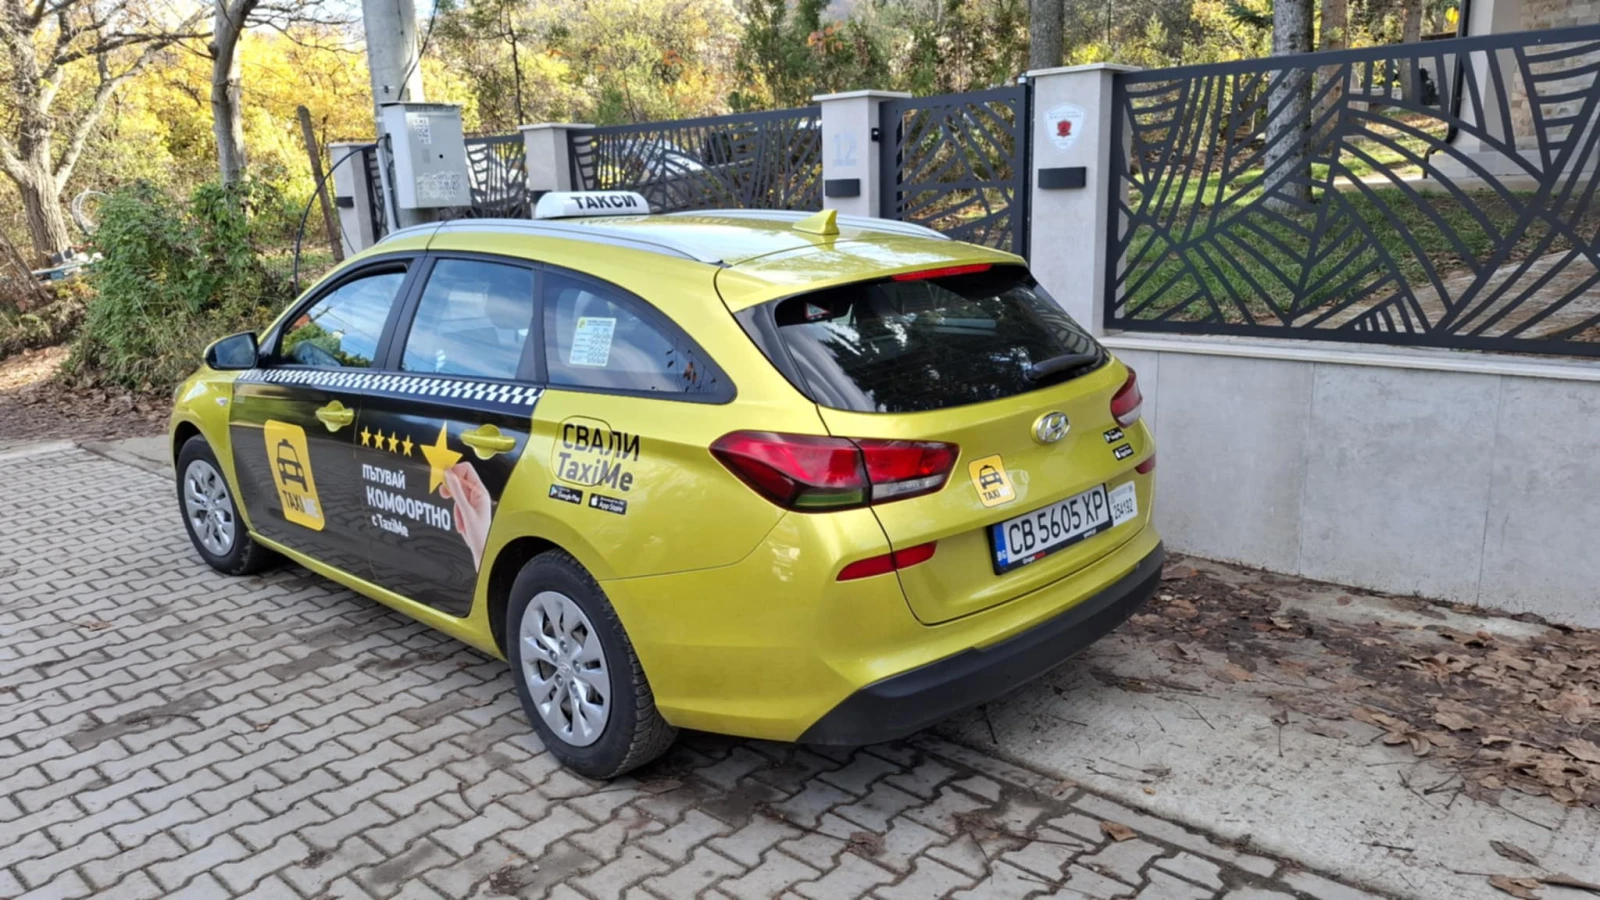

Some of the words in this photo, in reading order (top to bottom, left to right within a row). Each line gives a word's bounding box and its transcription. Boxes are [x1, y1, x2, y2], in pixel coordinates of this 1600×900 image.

[570, 194, 638, 210] ТАКСИ
[562, 422, 640, 462] СВАЛИ
[362, 463, 406, 490] ПЪТУВАЙ
[557, 451, 634, 492] TaxiMe
[366, 485, 451, 531] КОМФОРТНО
[1037, 500, 1082, 544] 5605
